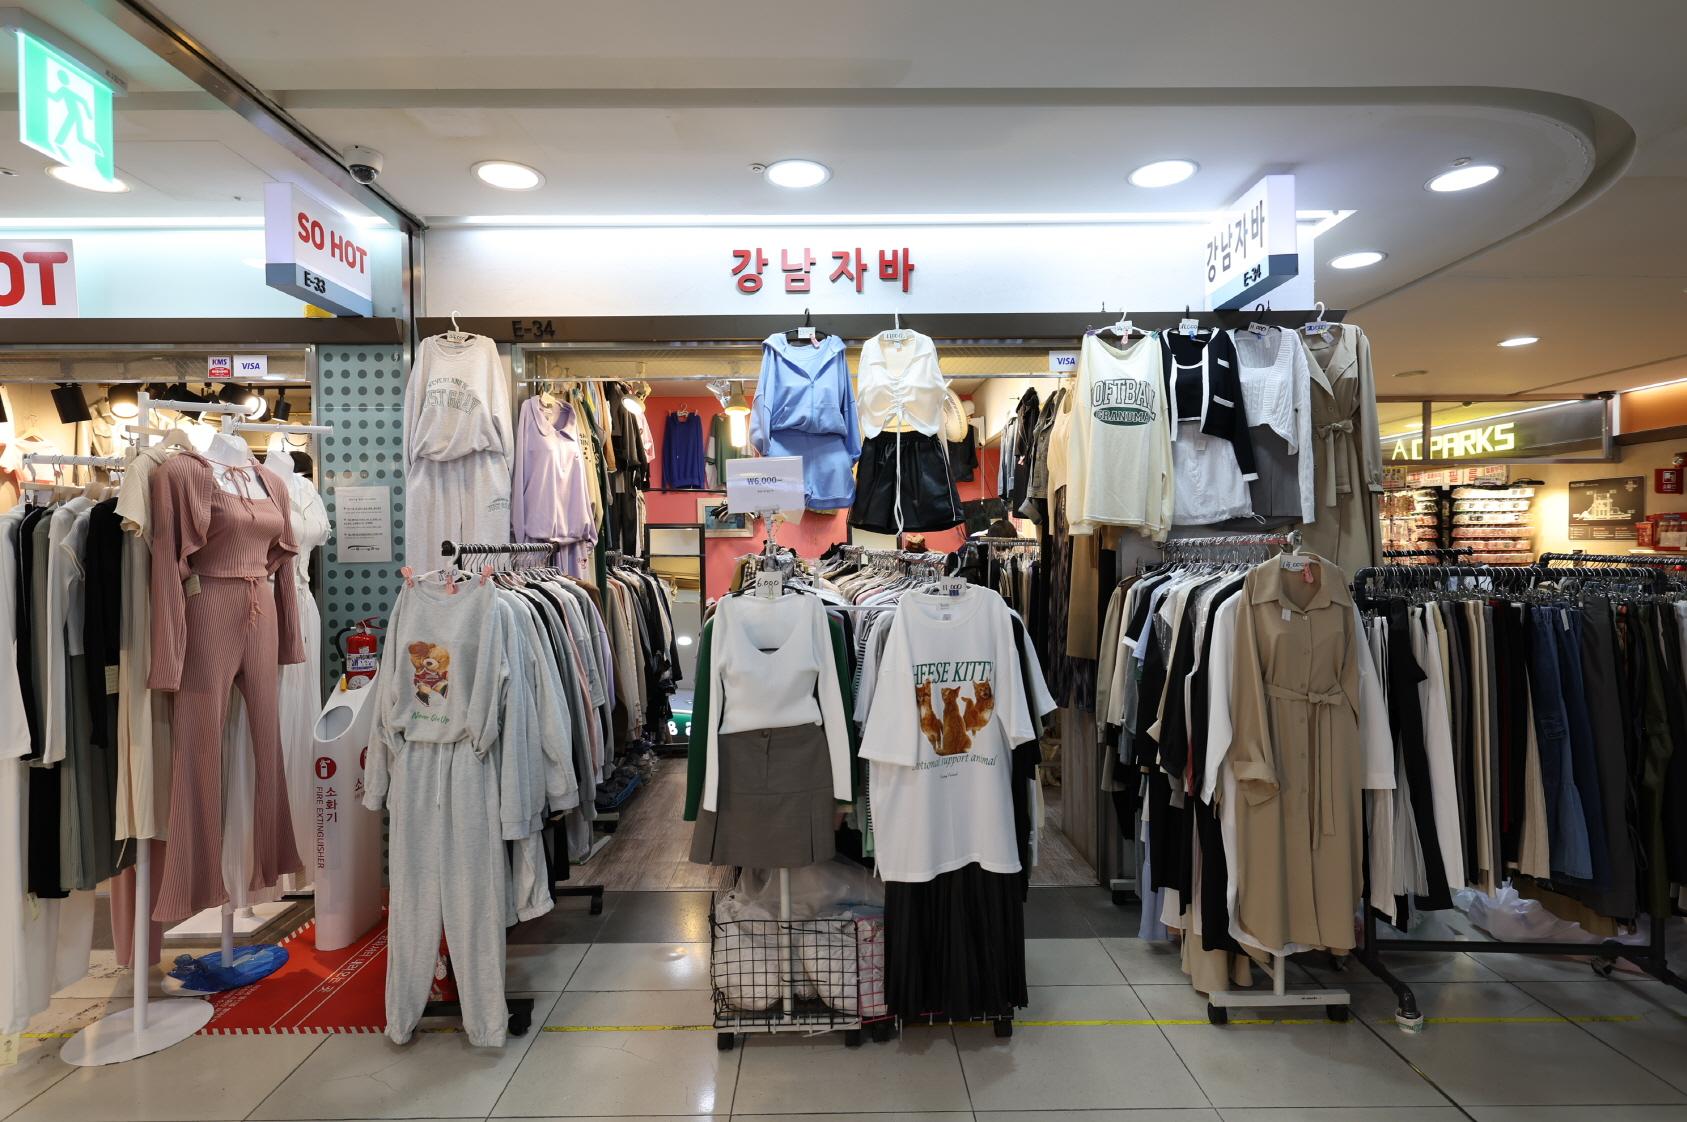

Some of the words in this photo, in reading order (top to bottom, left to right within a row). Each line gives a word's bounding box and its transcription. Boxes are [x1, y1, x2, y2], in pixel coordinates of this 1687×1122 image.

[297, 211, 325, 251] SO
[330, 230, 368, 274] HOT
[1207, 199, 1266, 283] 강남자바
[304, 270, 326, 294] E-33
[731, 247, 915, 293] 강남자바
[1243, 263, 1262, 287] E-34
[511, 320, 556, 339] E-34
[241, 362, 261, 370] VISA
[1056, 357, 1076, 366] VISA
[316, 786, 324, 805] FIRE
[325, 786, 338, 824] 소화기
[316, 808, 325, 869] EXTINGUISHER
